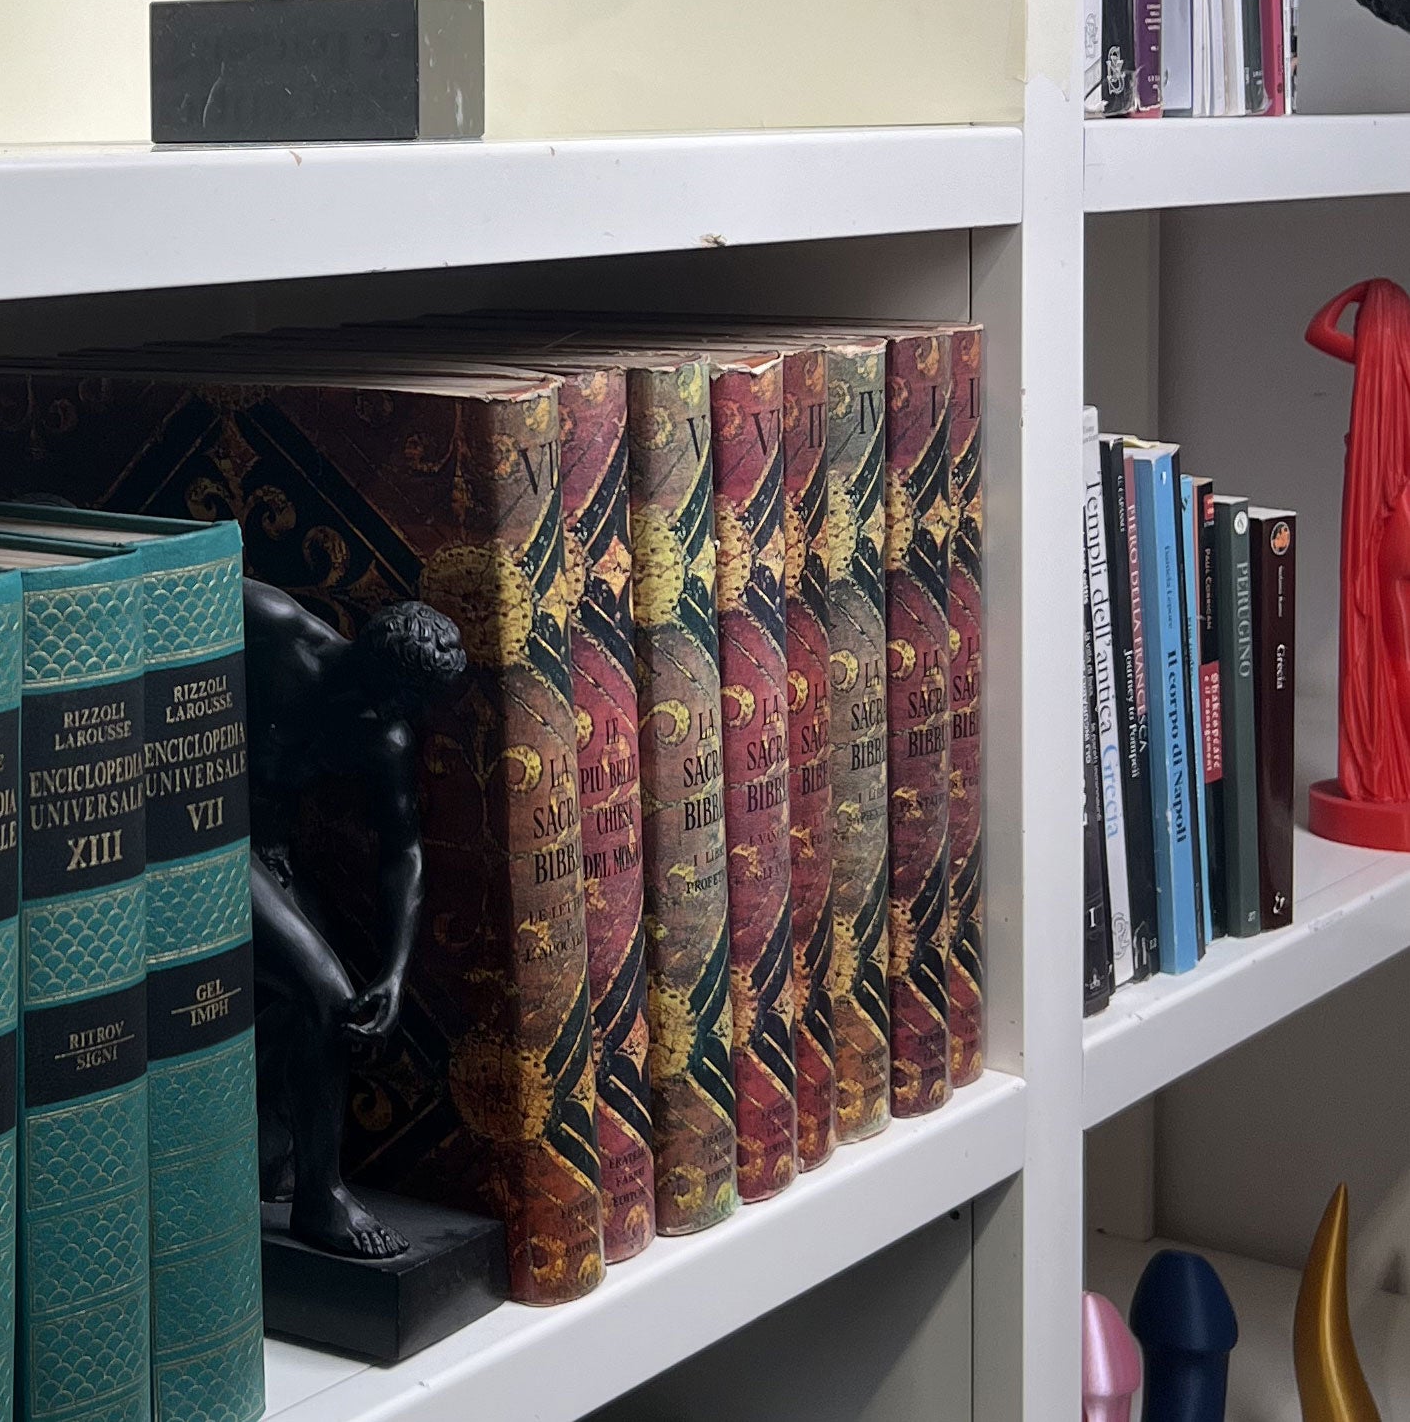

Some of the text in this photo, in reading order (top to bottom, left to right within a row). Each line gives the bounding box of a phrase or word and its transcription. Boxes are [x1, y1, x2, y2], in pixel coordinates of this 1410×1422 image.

[1086, 470, 1108, 577] Templi
[1127, 503, 1148, 753] PIERO DELLA FRANCESCA
[1236, 561, 1251, 677] PERUGINO
[1090, 588, 1115, 735] dell'antica
[1275, 643, 1286, 690] Grecia
[166, 692, 233, 724] LAROUSSE
[173, 674, 227, 703] RIZZOLI
[54, 720, 133, 752] LAROUSSE
[63, 701, 126, 729] RIZZOLI
[605, 717, 620, 745] LE
[1123, 648, 1141, 778] Journey to Pompeii
[1204, 698, 1213, 771] management
[1211, 672, 1221, 769] Shakespeare
[144, 720, 246, 768] ENCICLOPEDIA
[1167, 648, 1187, 843] Il corpo di Napoli
[30, 750, 143, 799] ENCICLOPEDIA
[145, 749, 247, 797] UNIVERSALE
[1101, 744, 1122, 839] Grecia
[30, 781, 144, 832] UNIVERSALE
[186, 796, 225, 834] VII
[66, 829, 124, 872] XIII
[189, 998, 229, 1028] IMPH
[195, 979, 225, 1002] GEL
[69, 1020, 125, 1051] RITROV
[76, 1044, 119, 1072] SIGNI
